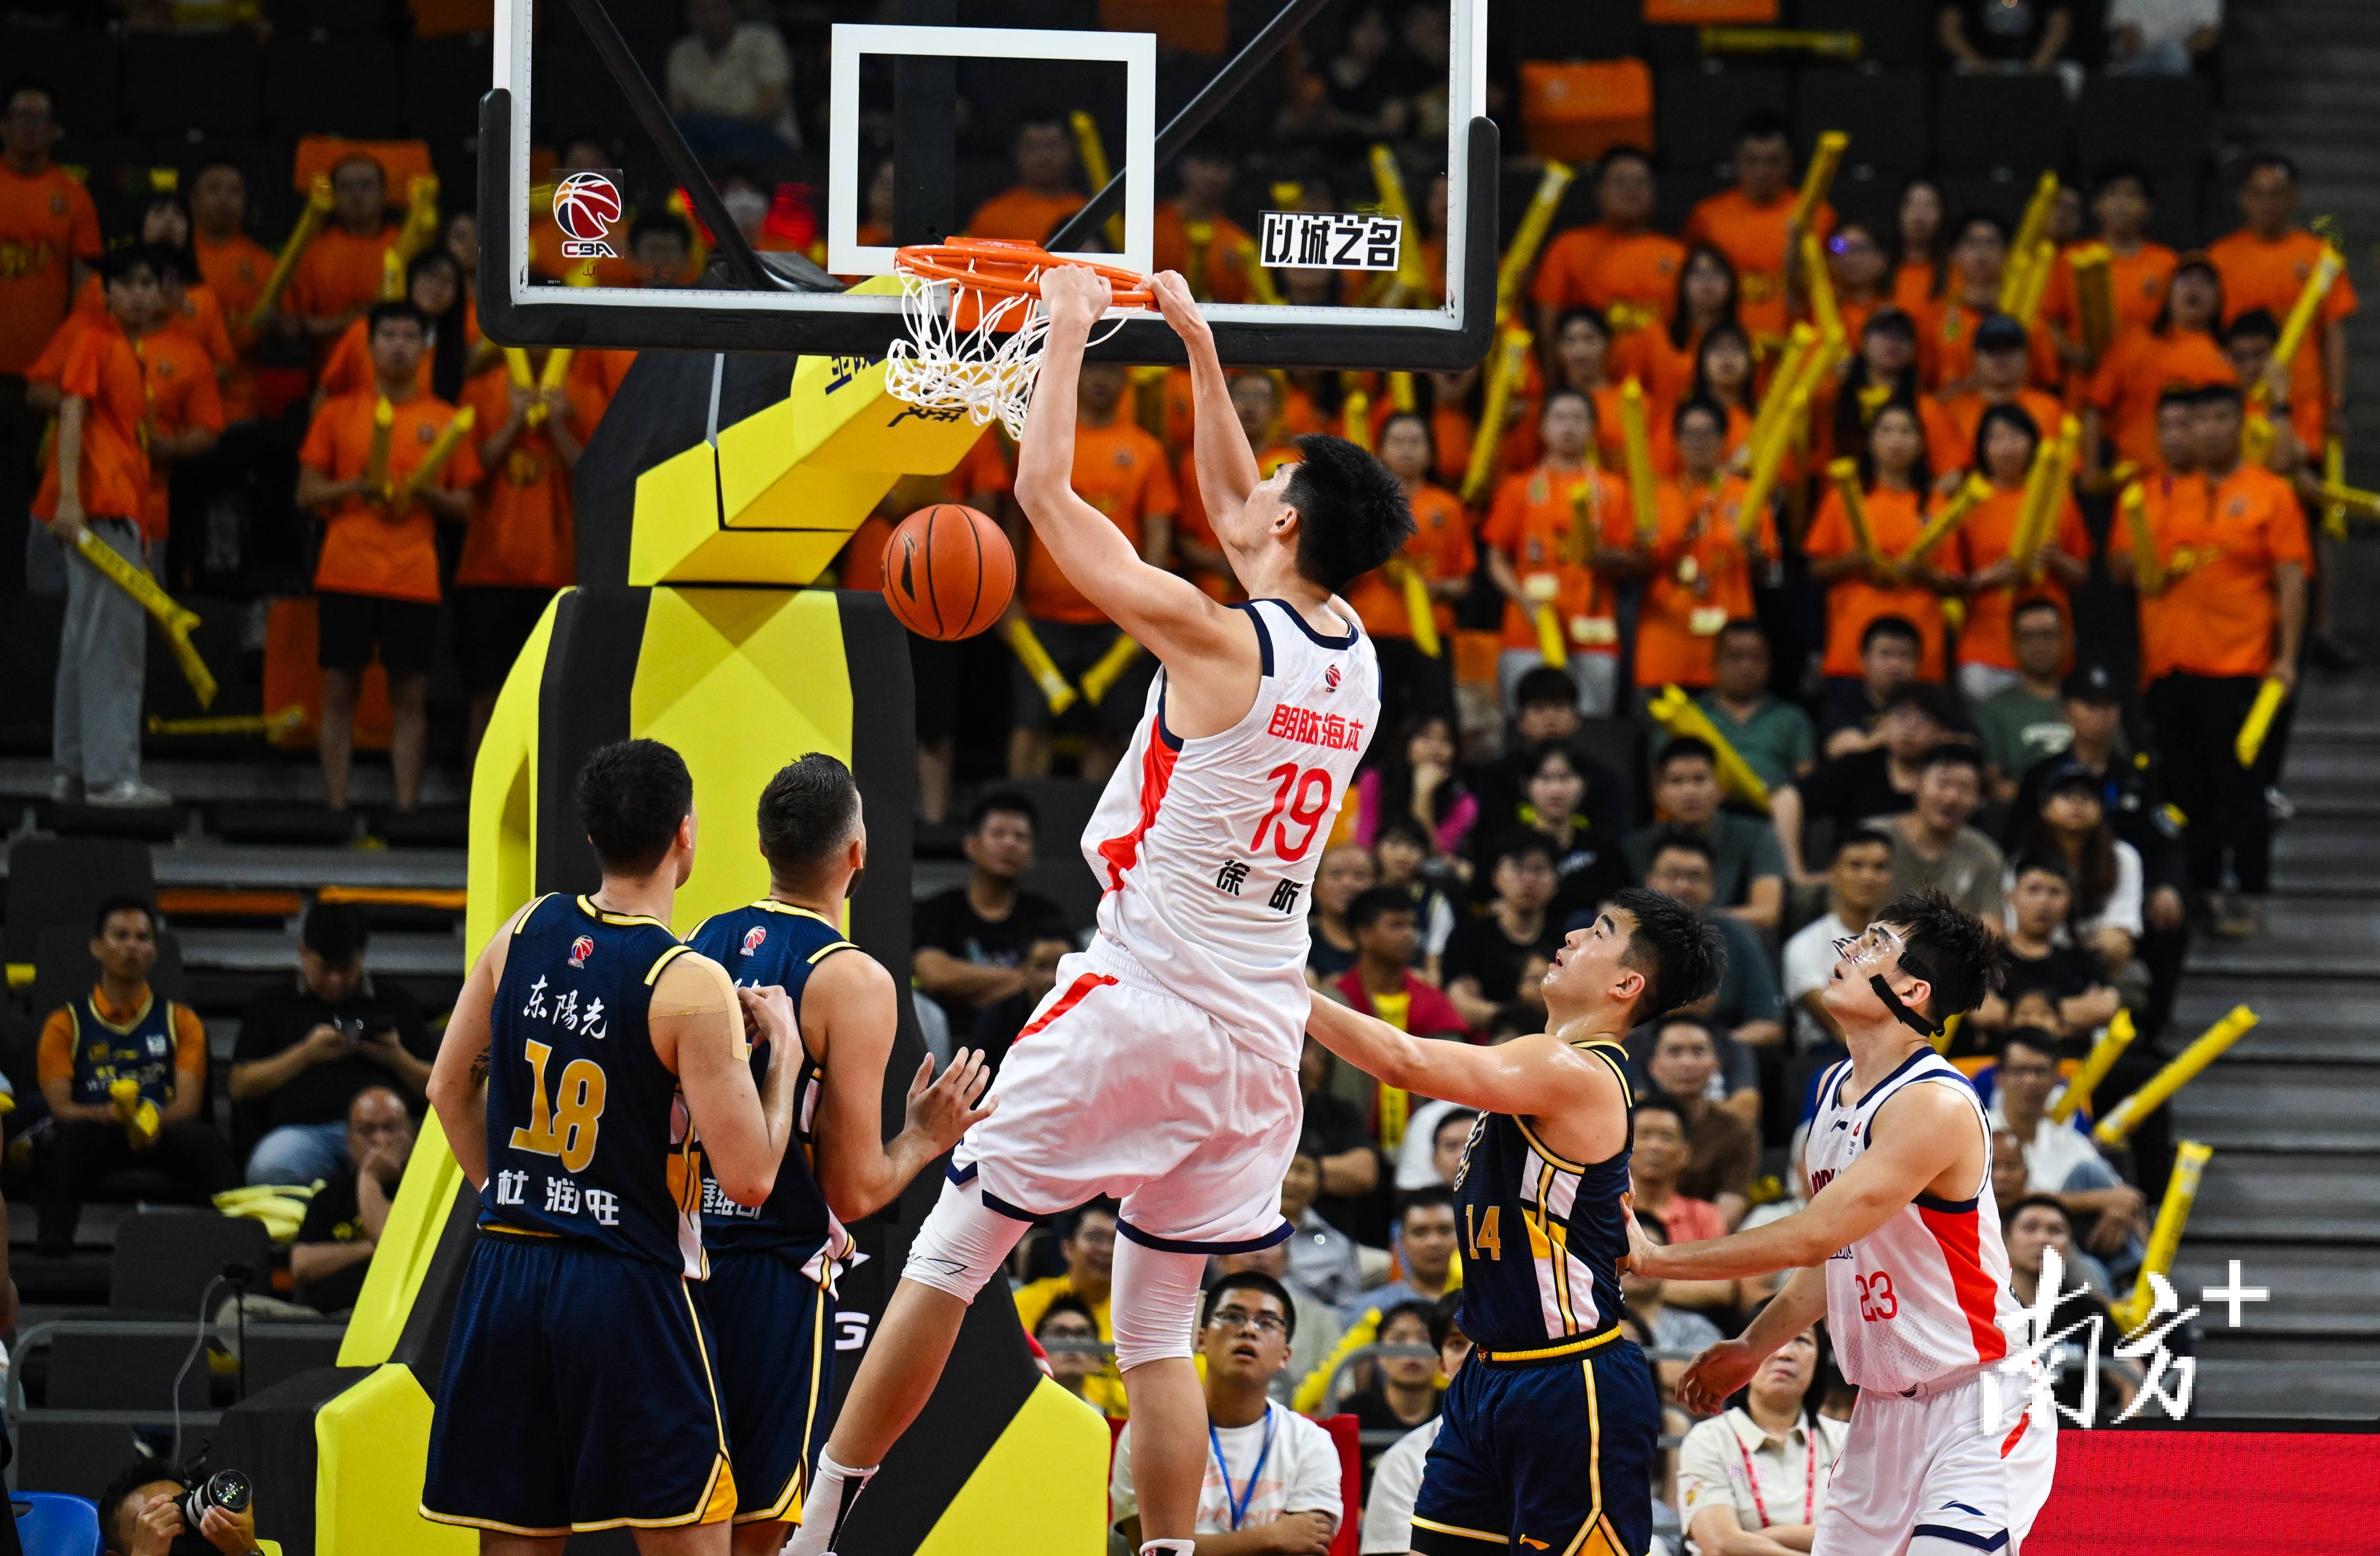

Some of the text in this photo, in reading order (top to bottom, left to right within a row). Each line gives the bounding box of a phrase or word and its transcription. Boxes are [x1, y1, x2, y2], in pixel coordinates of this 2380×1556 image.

[562, 241, 616, 257] CBA
[1264, 218, 1398, 267] 以城之名
[1250, 762, 1332, 862] 19
[568, 957, 585, 969] CBA
[509, 1038, 607, 1173] 18
[1466, 1204, 1501, 1260] 14
[1855, 1270, 1898, 1322] 23
